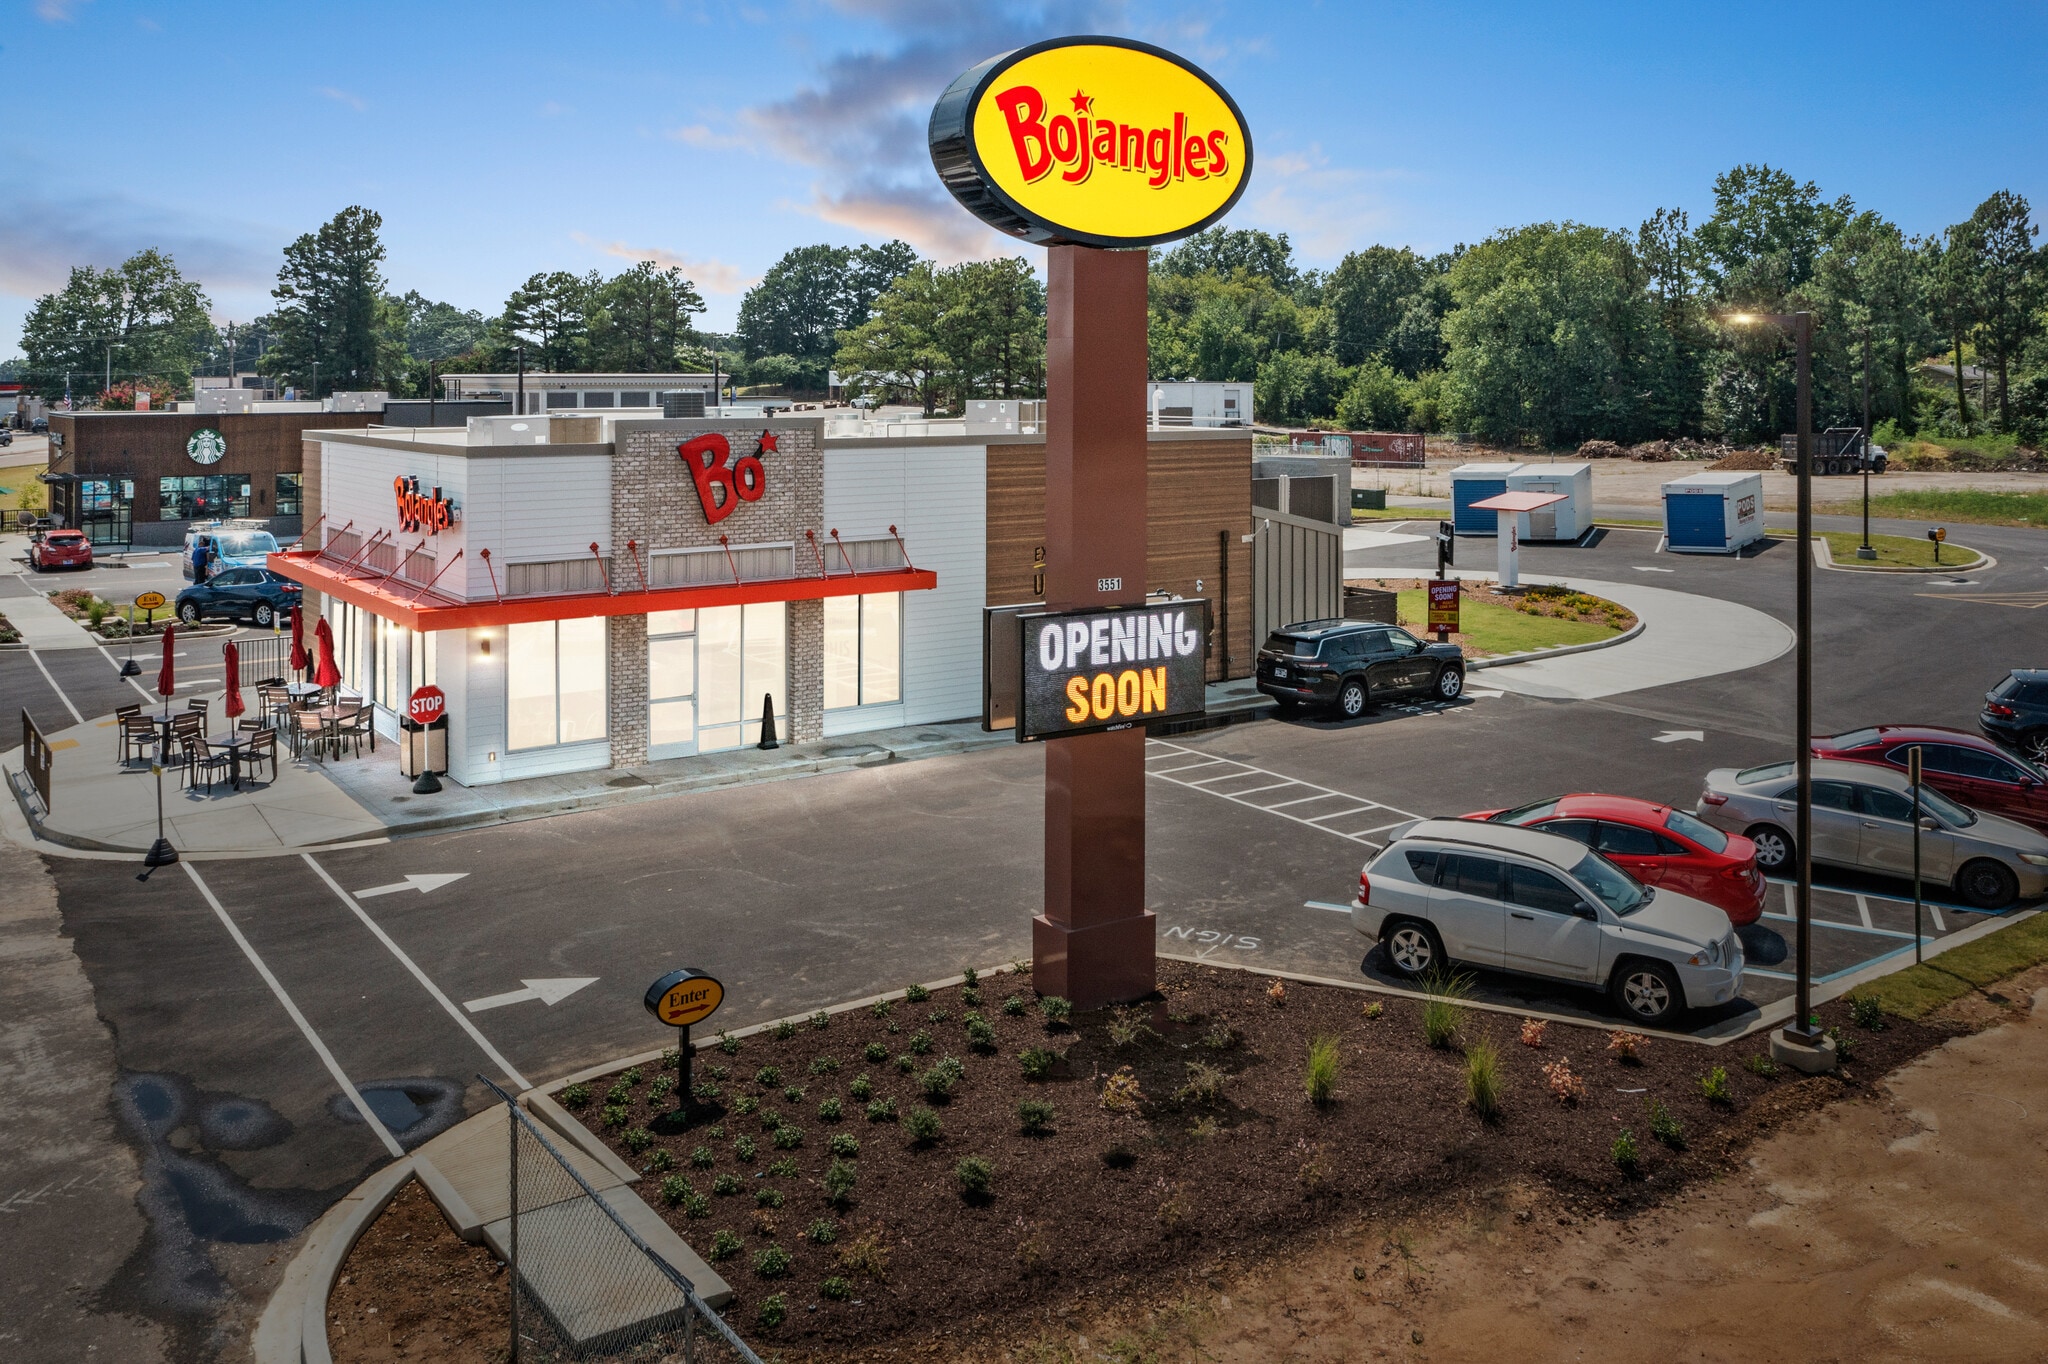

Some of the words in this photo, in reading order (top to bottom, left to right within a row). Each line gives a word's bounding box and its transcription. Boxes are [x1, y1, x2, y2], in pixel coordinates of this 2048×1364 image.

[995, 85, 1229, 190] Bojangles
[676, 433, 766, 525] Bo
[394, 473, 454, 536] Bojangles
[1099, 579, 1120, 590] 3551
[1431, 586, 1457, 595] OPENING
[1039, 611, 1197, 671] OPENING
[411, 695, 443, 714] STOP
[1065, 666, 1167, 723] SOON
[1163, 926, 1262, 949] SIGN
[669, 988, 710, 1008] Enter
